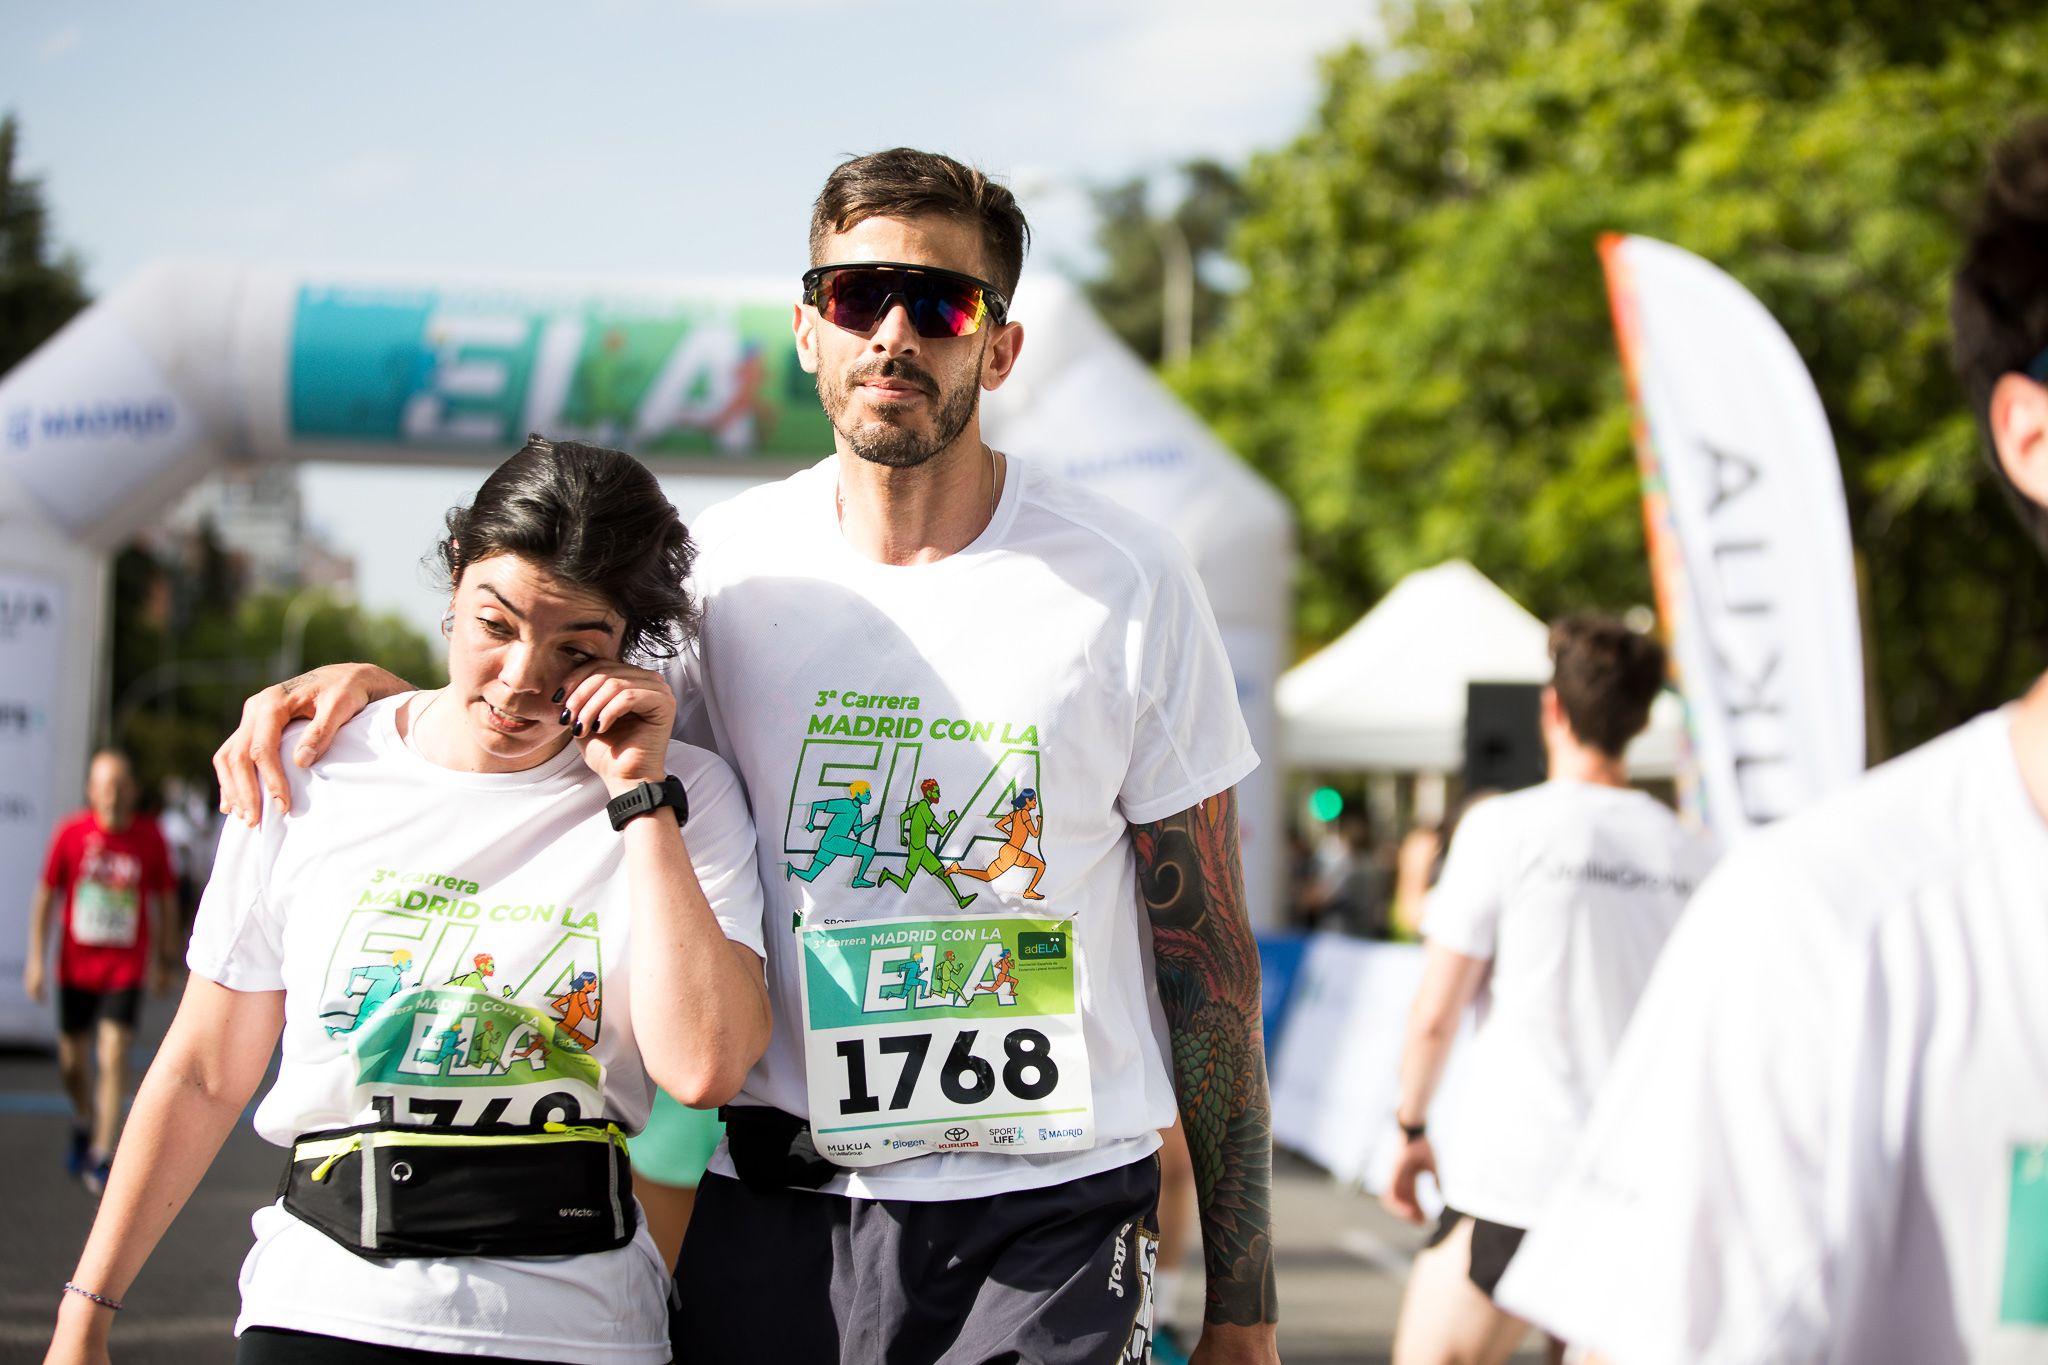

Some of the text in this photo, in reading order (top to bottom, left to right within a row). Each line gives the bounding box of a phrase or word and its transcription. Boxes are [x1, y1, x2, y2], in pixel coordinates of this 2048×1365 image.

[406, 317, 758, 456] ELA
[814, 690, 920, 710] 3ª Carrera
[807, 714, 1039, 746] MADRID CON LA
[784, 739, 1047, 862] ELA
[357, 889, 600, 931] MADRID CON LA
[827, 936, 866, 948] Carrera
[871, 927, 1002, 946] MADRID CON LA
[1024, 943, 1060, 954] adELA
[861, 942, 1017, 1014] ELA
[396, 1010, 548, 1076] ELA
[836, 1027, 1059, 1115] 1768
[989, 1127, 1016, 1136] SPORT
[994, 1136, 1014, 1144] LIFE
[1049, 1128, 1083, 1138] MADRID
[827, 1142, 872, 1151] MUKUA
[892, 1139, 926, 1149] Biogen
[1108, 1223, 1132, 1298] Joma
